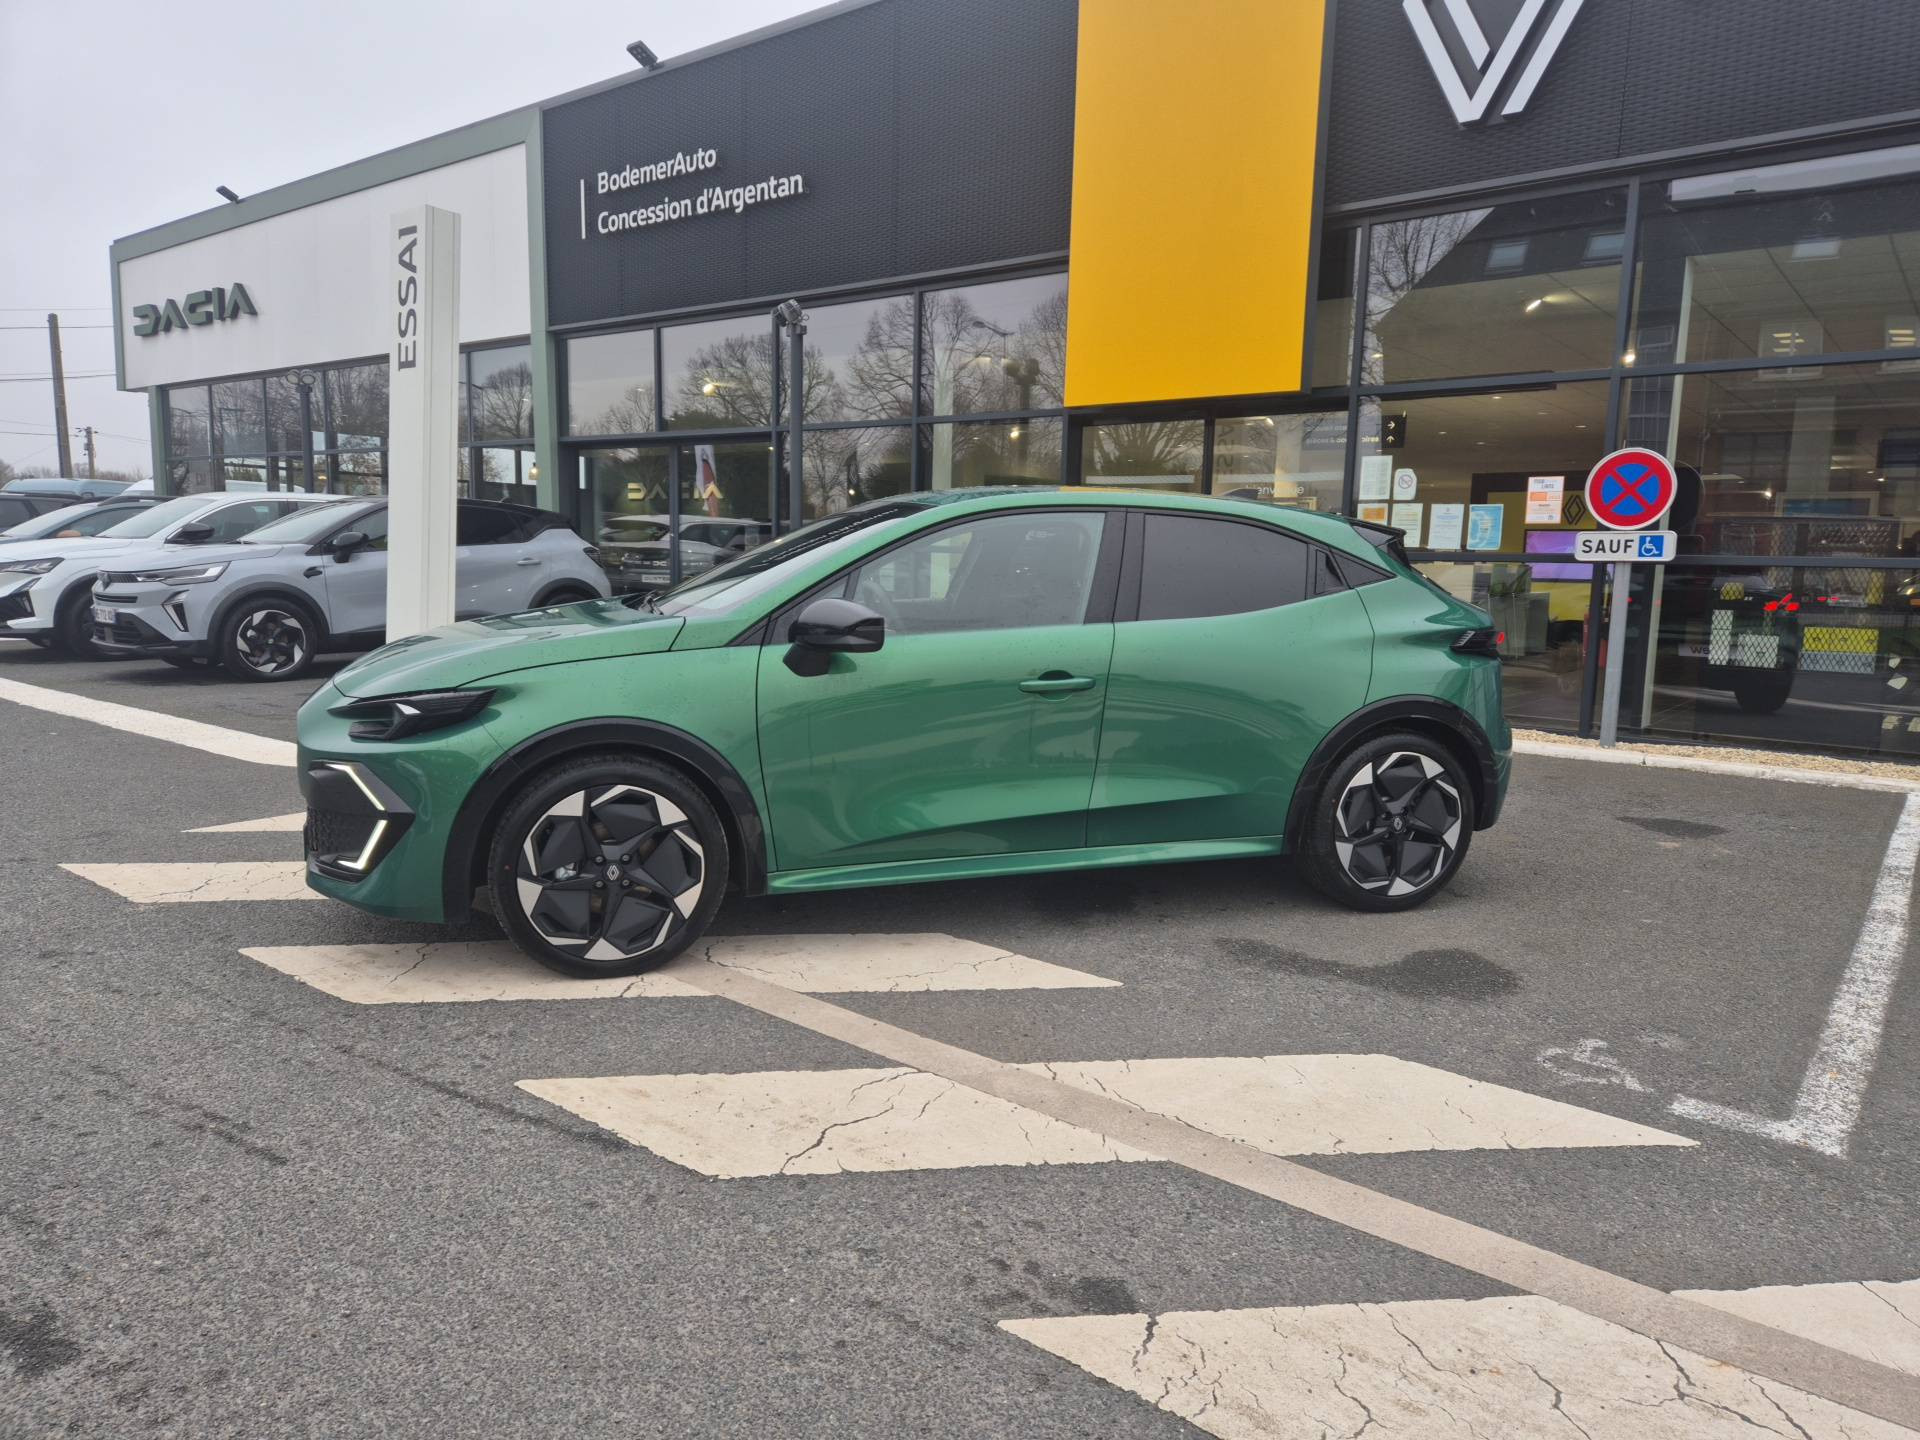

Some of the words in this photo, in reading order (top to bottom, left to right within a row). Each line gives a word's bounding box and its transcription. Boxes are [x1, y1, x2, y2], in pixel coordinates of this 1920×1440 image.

[597, 148, 718, 194] BodemerAuto
[597, 197, 693, 234] Concession
[696, 174, 804, 213] d'Argentan
[133, 282, 258, 337] DACIA
[397, 225, 418, 372] ESSAI
[1581, 539, 1634, 554] SAUF
